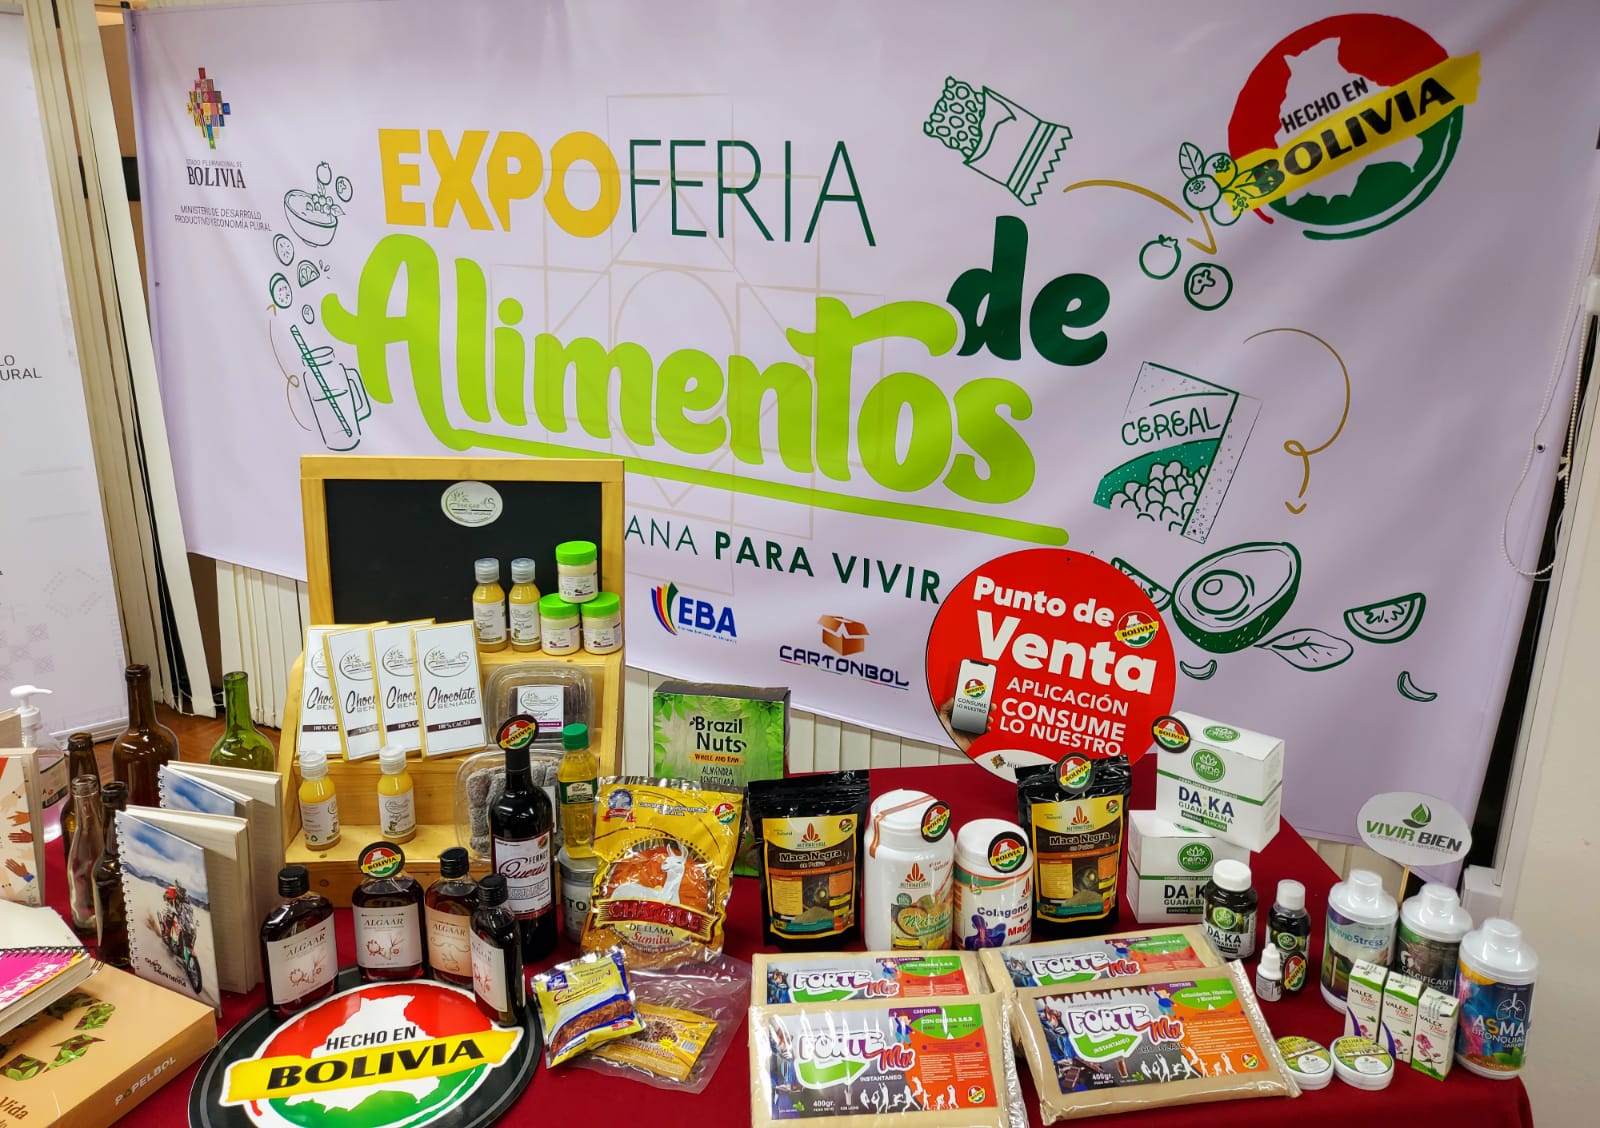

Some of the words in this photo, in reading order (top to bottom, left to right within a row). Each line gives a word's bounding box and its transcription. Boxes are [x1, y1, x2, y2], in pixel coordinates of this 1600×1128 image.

[1281, 91, 1341, 134] HECHO
[1342, 77, 1369, 102] EN
[1254, 77, 1455, 194] BOLIVIA
[187, 166, 246, 189] BOLIVIA
[378, 128, 876, 246] EXPOFERIA
[947, 215, 1110, 366] de
[321, 233, 1036, 504] Alimentos
[1121, 407, 1221, 446] CEREAL
[715, 531, 814, 577] PARA
[832, 552, 940, 604] VIVIR
[973, 575, 1066, 617] Punto
[1073, 598, 1115, 627] de
[679, 596, 737, 638] EBA
[1121, 624, 1154, 638] BOLIVIA
[976, 610, 1157, 695] Venta
[779, 645, 909, 687] CARTONBOL
[427, 686, 476, 710] Chocolate
[957, 697, 987, 709] CONSUME
[1006, 677, 1129, 717] APLICACIÓN
[695, 716, 743, 734] Brazil
[1001, 698, 1126, 742] CONSUME
[506, 726, 532, 745] BOLIVIA
[696, 732, 742, 753] Nuts
[1000, 716, 1025, 734] LO
[1029, 722, 1122, 757] NUESTRO
[1159, 729, 1184, 741] BOLIVIA
[1066, 765, 1088, 782] BOLIVIA
[927, 813, 947, 830] BOLIVIA
[1178, 801, 1234, 824] GUANABANA
[1050, 836, 1079, 846] Maca
[1080, 832, 1111, 844] Negra
[1366, 820, 1416, 842] VIVIR
[1417, 831, 1462, 852] BIEN
[368, 857, 397, 871] BOLIVIA
[780, 852, 810, 863] Maca
[811, 850, 842, 861] Negra
[996, 849, 1021, 863] BOLIVIA
[608, 901, 701, 929] CHARQUE
[977, 903, 1028, 918] Colageno
[364, 917, 404, 928] ALGAAR
[432, 922, 467, 937] ALGAAR
[629, 923, 641, 932] DE
[644, 924, 674, 936] LLAMA
[287, 933, 326, 958] ALGAAR
[633, 930, 670, 945] Sumita
[1032, 953, 1109, 976] FORTE
[793, 971, 872, 991] FORTE
[866, 979, 898, 997] Mix
[1350, 986, 1373, 999] VALEX
[1385, 1000, 1409, 1012] VALEX
[1068, 1006, 1151, 1034] FORTE
[1150, 1019, 1181, 1043] Mix
[1420, 1014, 1443, 1027] VALEX
[1473, 1014, 1525, 1037] ASMA
[326, 1030, 388, 1051] HECHO
[393, 1026, 417, 1042] EN
[266, 1039, 485, 1090] BOLIVIA
[879, 1045, 913, 1071] Mix
[813, 1100, 835, 1108] 400gr.
